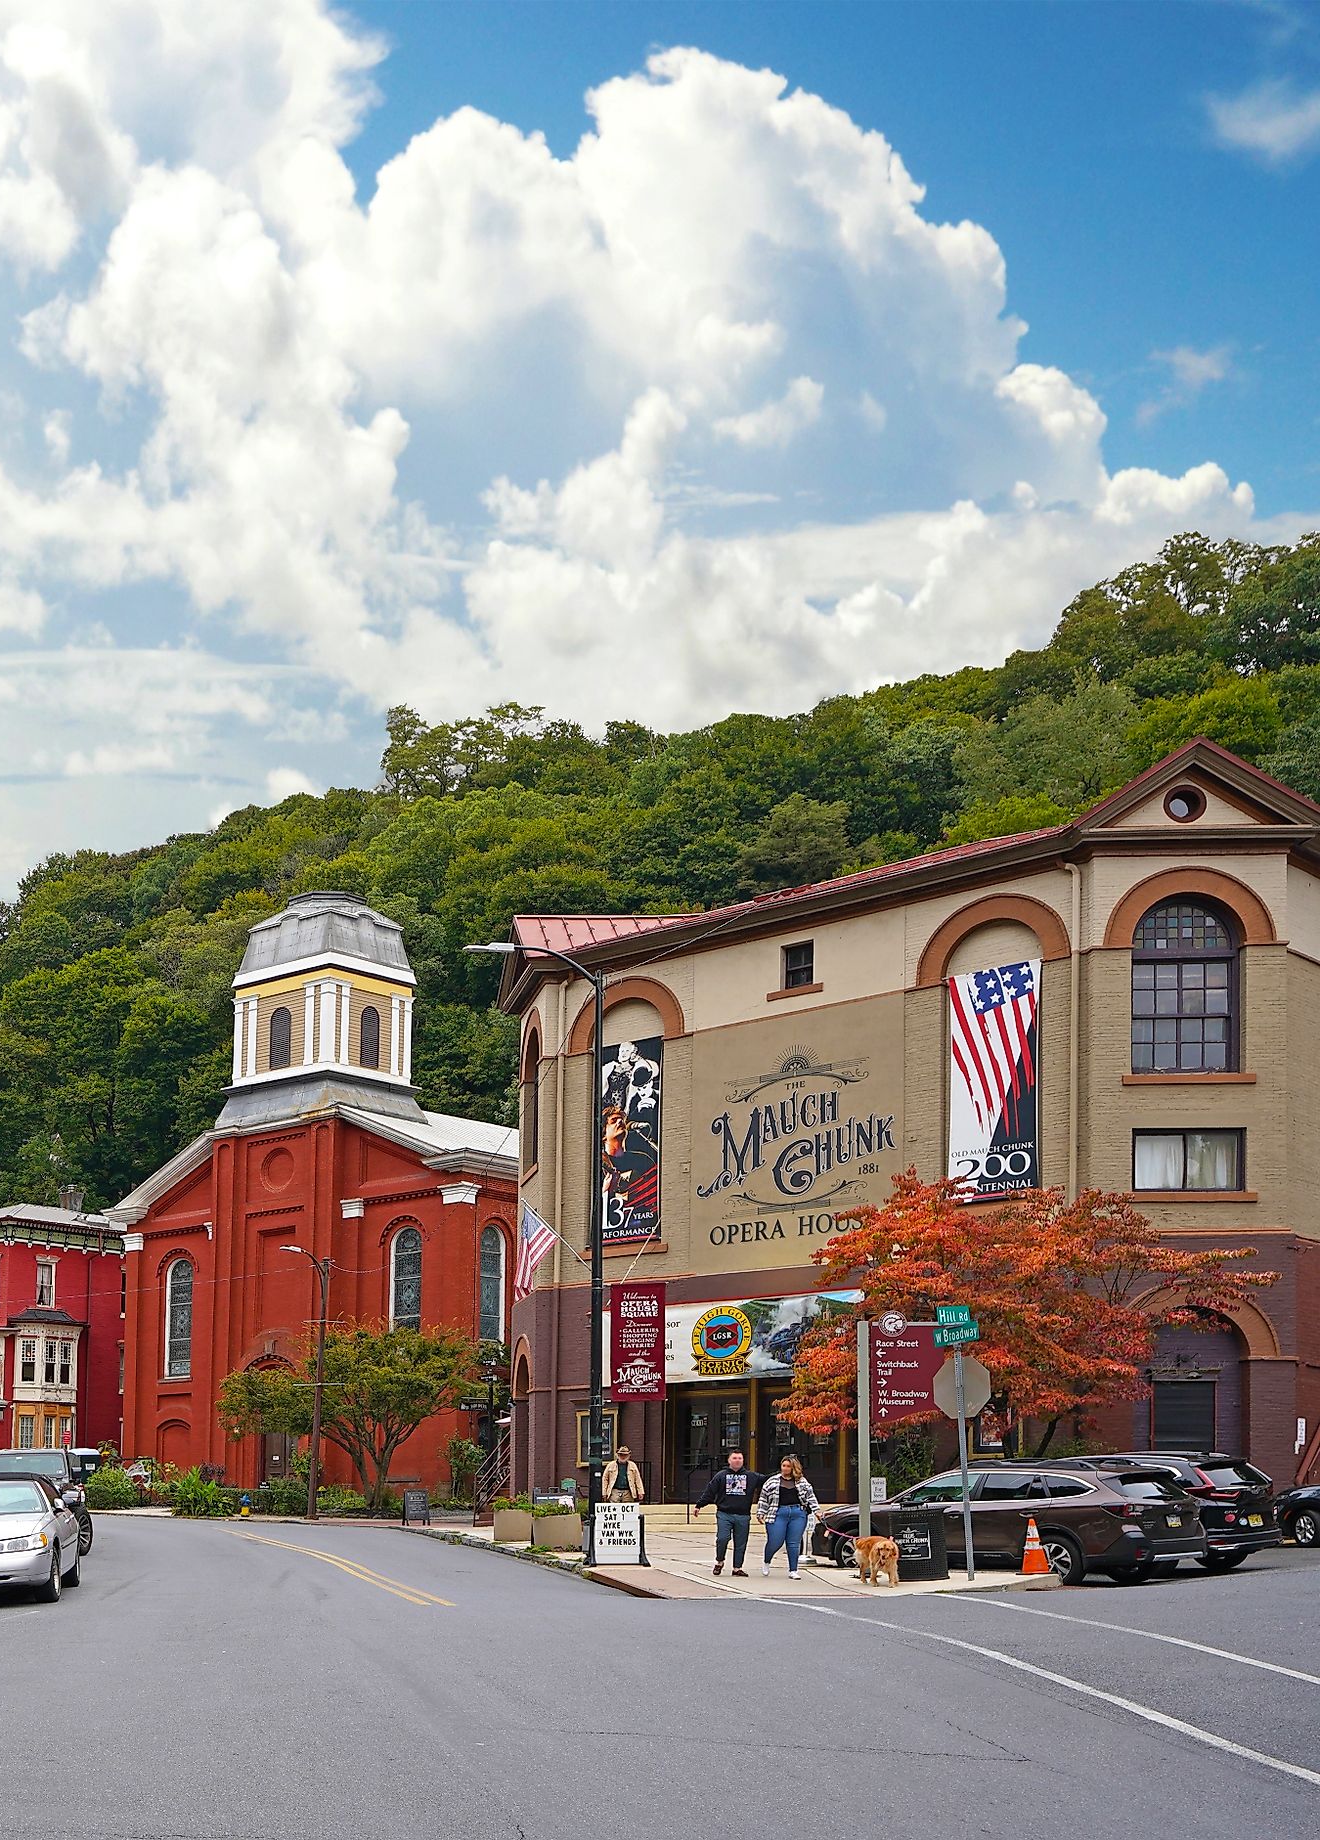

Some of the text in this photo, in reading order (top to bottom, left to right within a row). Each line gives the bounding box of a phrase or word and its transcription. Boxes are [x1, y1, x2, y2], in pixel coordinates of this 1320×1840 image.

[785, 1080, 806, 1090] THE
[697, 1090, 839, 1199] MAUCH
[951, 1140, 1034, 1159] OLD MAUCH CHUNK
[772, 1113, 896, 1196] CHUNK
[858, 1163, 880, 1175] 1881
[956, 1150, 1032, 1182] 200
[976, 1179, 1034, 1193] NTENNIAL
[602, 1190, 654, 1230] 137 YEARS
[602, 1226, 656, 1239] RFORMANCE
[709, 1212, 863, 1246] OPERA HOUS
[622, 1292, 650, 1301] Welcome
[938, 1310, 957, 1324] Hill
[693, 1308, 751, 1346] LEHIGH GORGE
[712, 1331, 732, 1341] LGSR
[942, 1326, 978, 1343] Broadway
[876, 1339, 919, 1348] Race Street
[700, 1358, 744, 1368] SCENIC
[876, 1360, 919, 1369] Switchback
[613, 1365, 650, 1384] MAUCH
[700, 1365, 743, 1374] RAILWAY
[876, 1368, 893, 1376] Trail
[631, 1371, 662, 1386] CHUNK
[878, 1389, 929, 1399] W. Broadway
[878, 1397, 915, 1406] Museums
[596, 1505, 635, 1513] LIVE OCT
[604, 1513, 617, 1521] SAT
[601, 1530, 634, 1538] VAN WYK
[607, 1538, 637, 1546] FRIENDS
